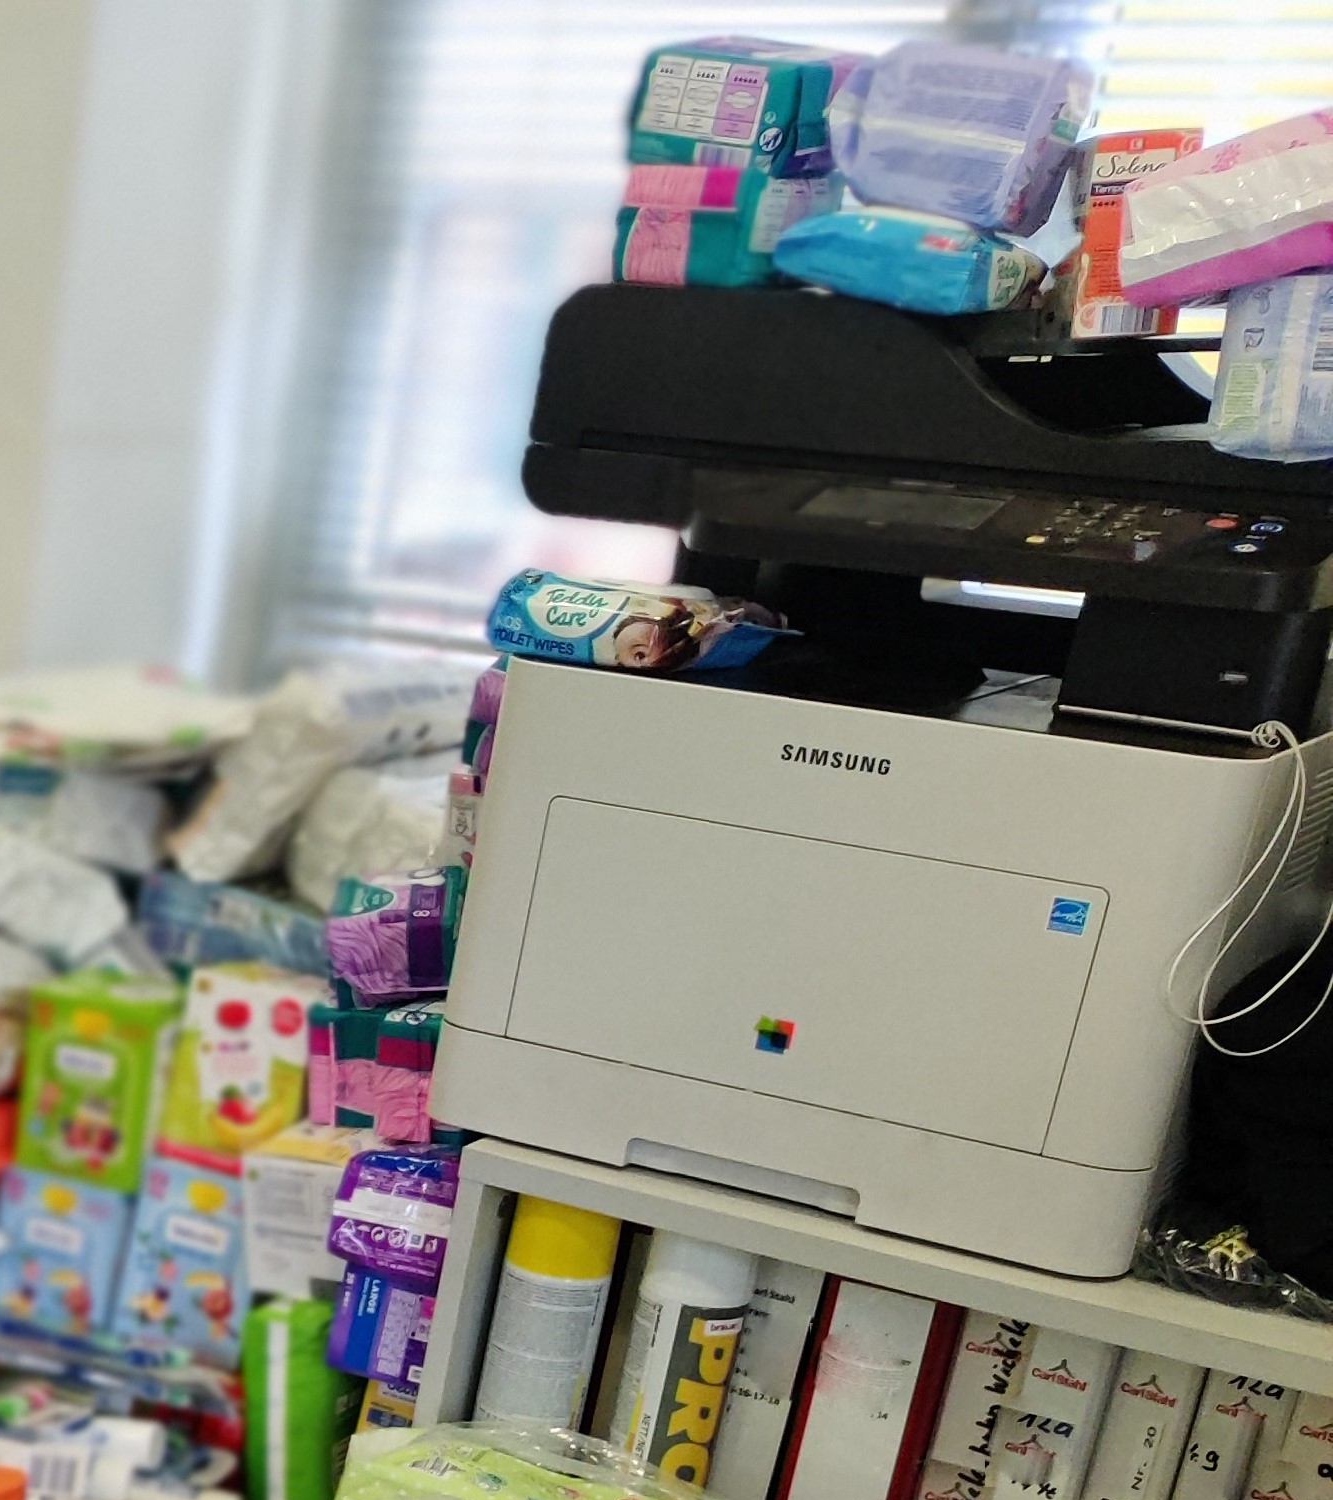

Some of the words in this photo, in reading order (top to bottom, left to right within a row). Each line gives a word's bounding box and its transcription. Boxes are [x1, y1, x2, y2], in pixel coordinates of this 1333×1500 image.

[533, 637, 575, 656] WIPES
[780, 743, 892, 777] SAMSUNG
[658, 1317, 738, 1490] PRO
